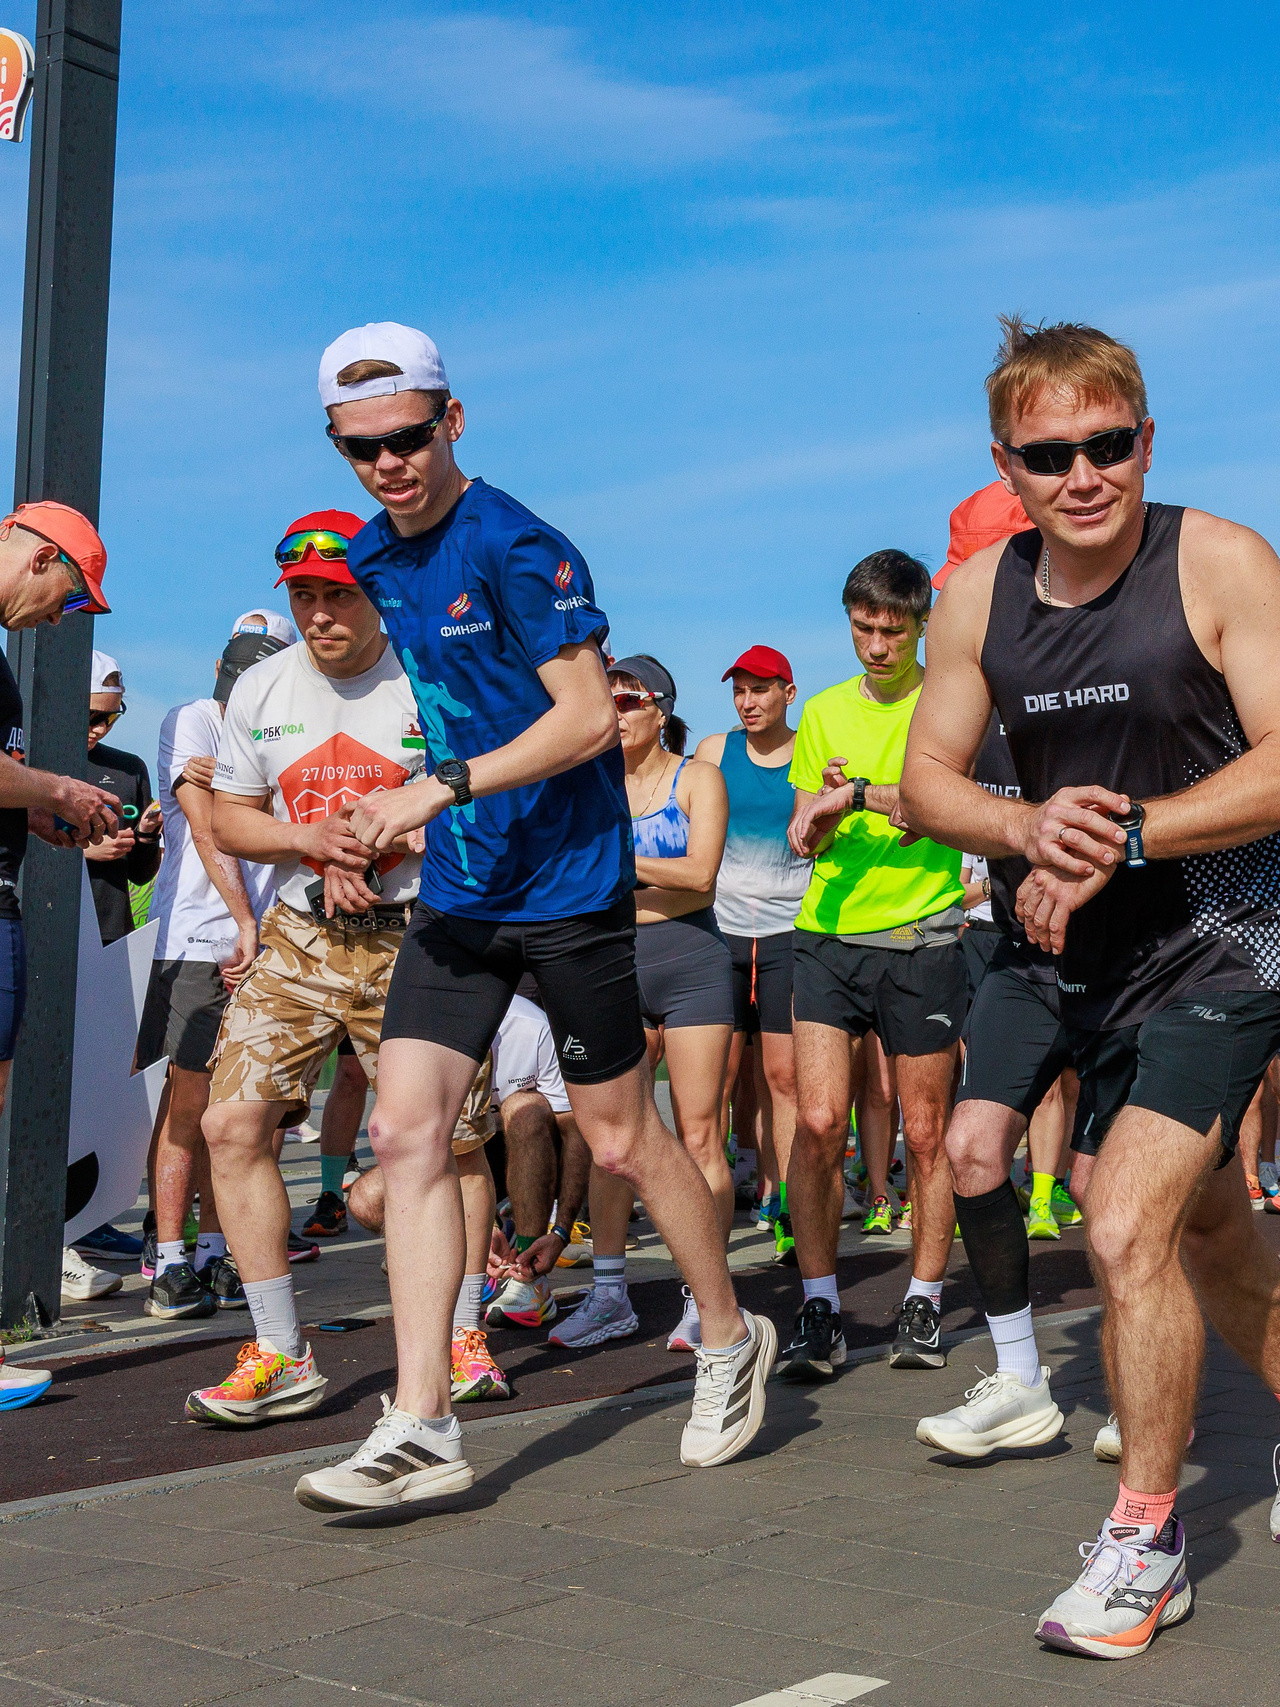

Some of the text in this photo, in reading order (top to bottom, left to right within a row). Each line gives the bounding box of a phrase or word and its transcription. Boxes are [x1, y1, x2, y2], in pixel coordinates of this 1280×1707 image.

[1023, 683, 1130, 713] DIE HARD
[301, 764, 383, 782] 27/09/2015
[1189, 1005, 1226, 1022] FILA
[1112, 1528, 1137, 1536] saucony
